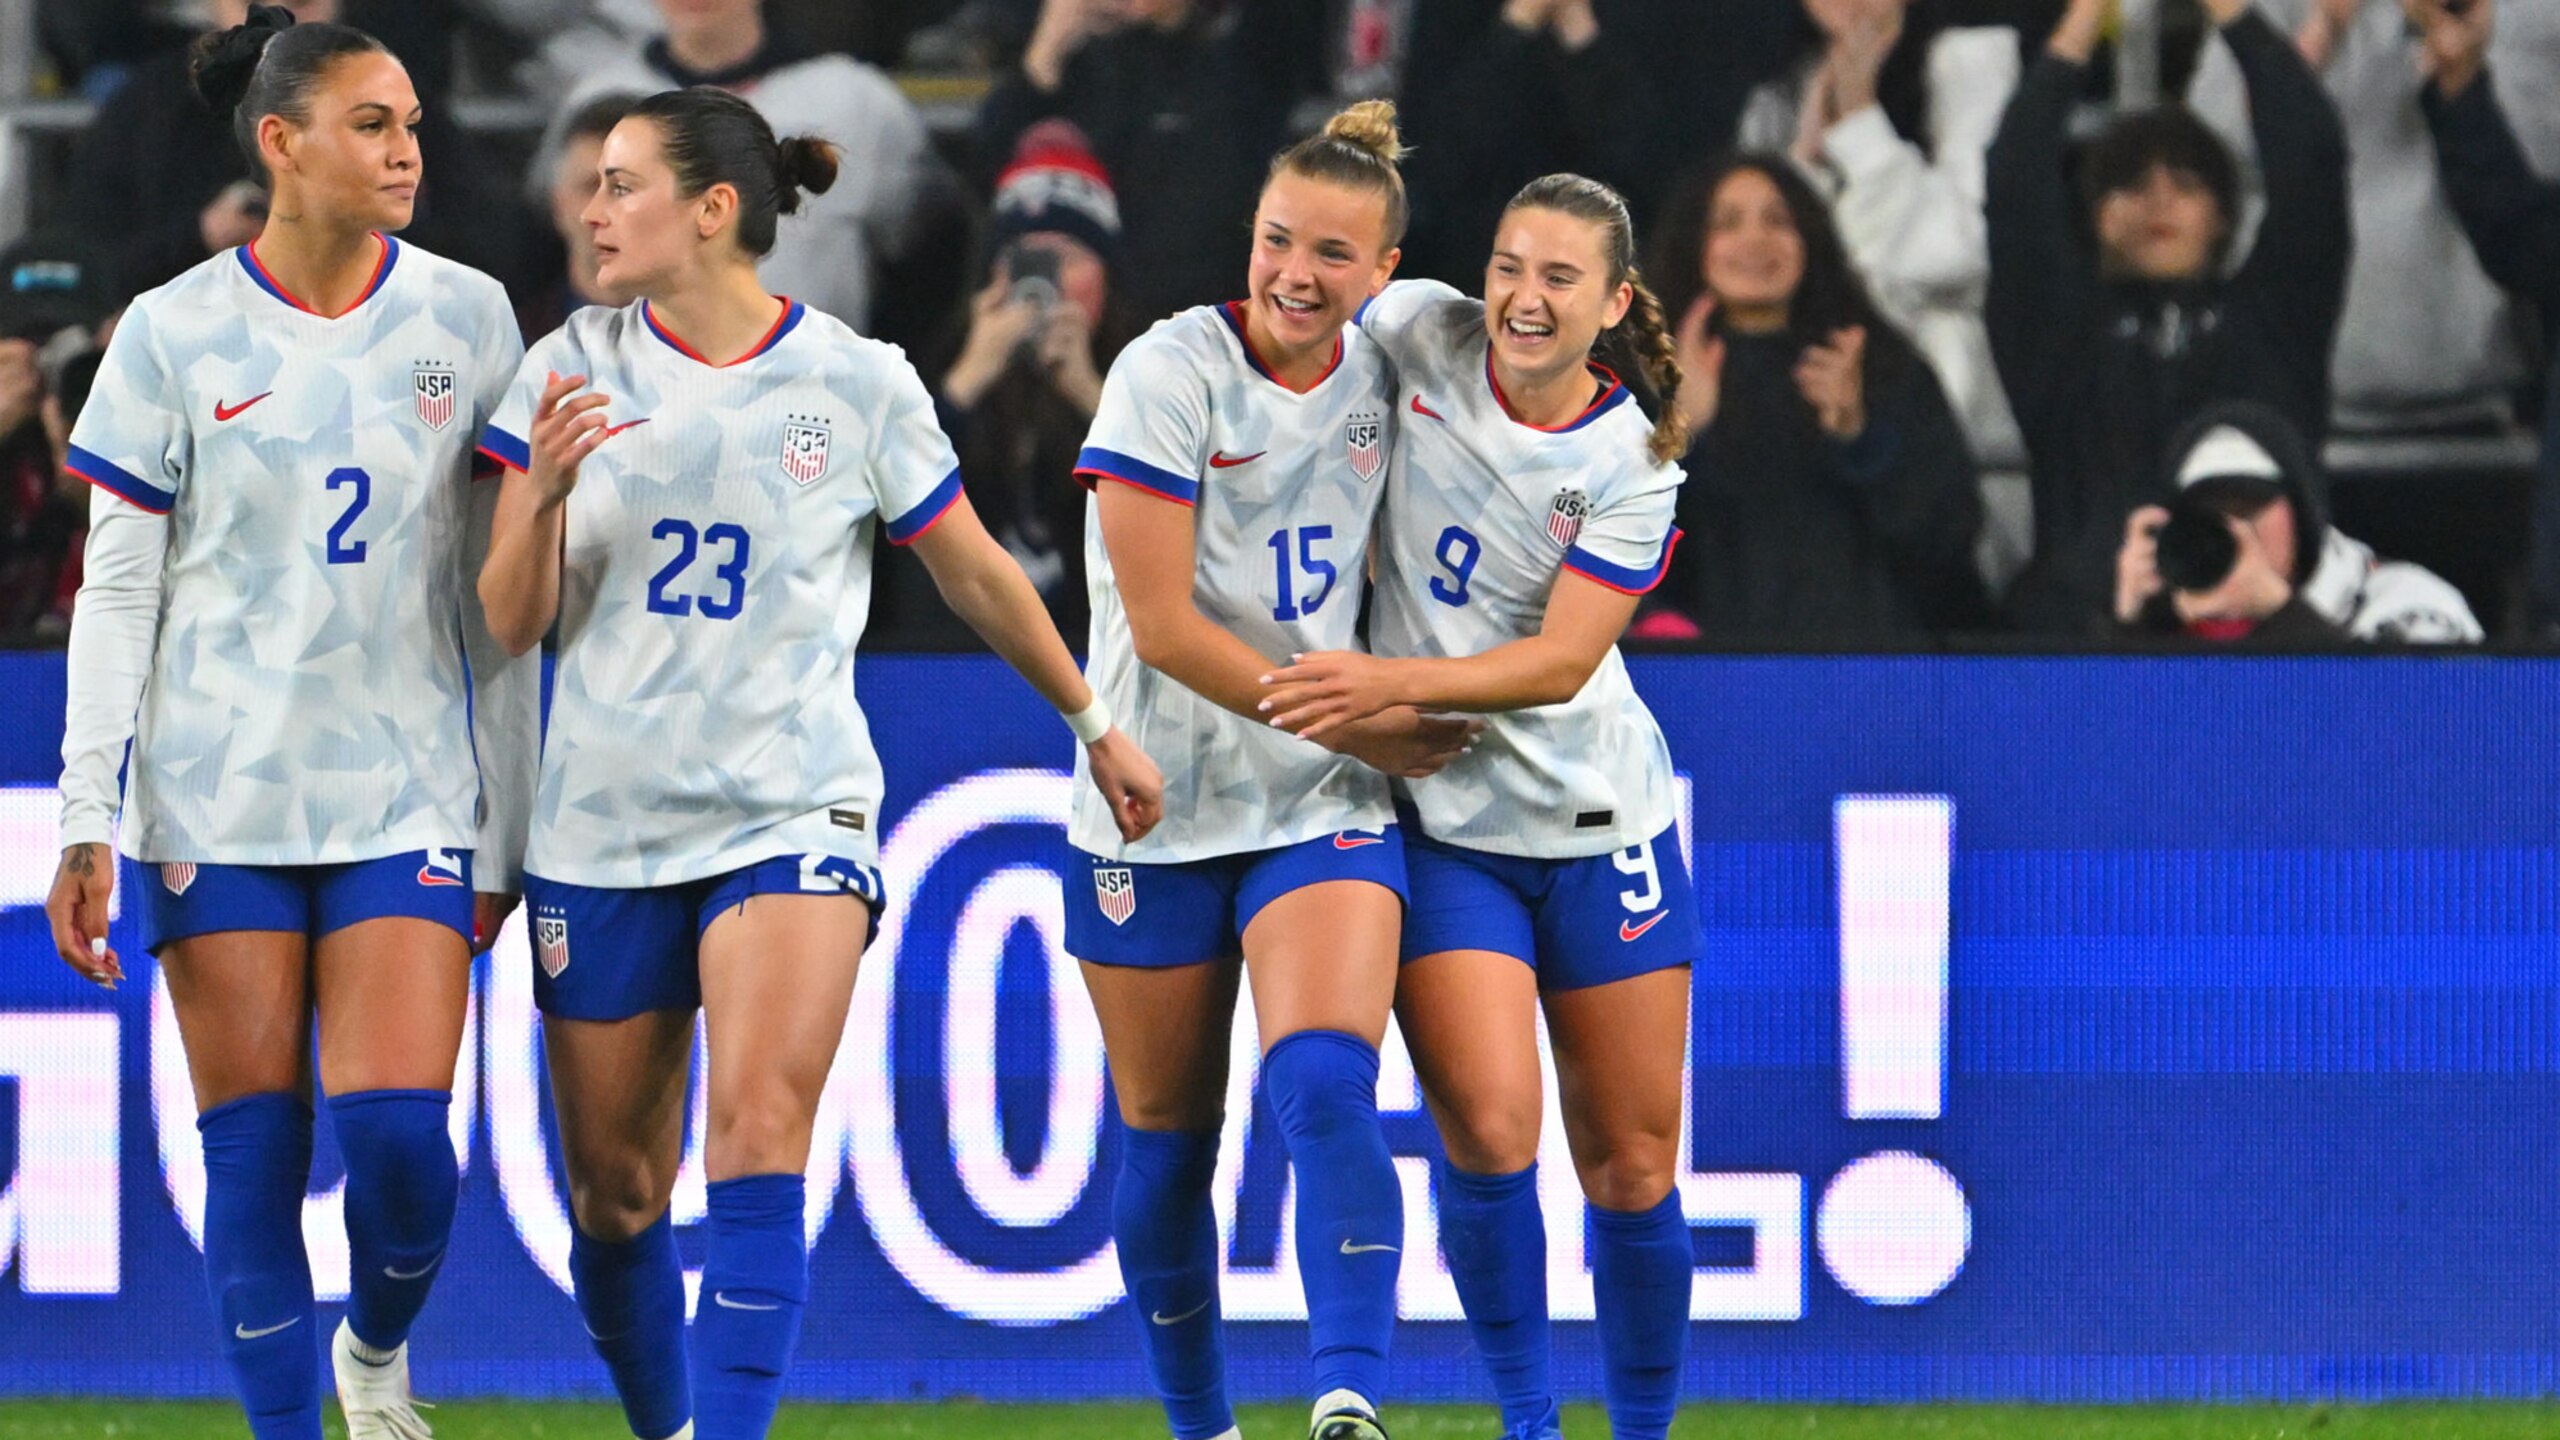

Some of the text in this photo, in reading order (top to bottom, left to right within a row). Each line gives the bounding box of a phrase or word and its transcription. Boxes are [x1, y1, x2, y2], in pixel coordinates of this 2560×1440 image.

[416, 373, 451, 398] USA
[1348, 425, 1378, 448] USA
[325, 467, 371, 564] 2
[646, 517, 751, 621] 23
[1267, 524, 1337, 621] 15
[1429, 525, 1482, 608] 9
[1096, 871, 1131, 894] USA
[1611, 840, 1662, 913] 9
[539, 921, 564, 944] USA
